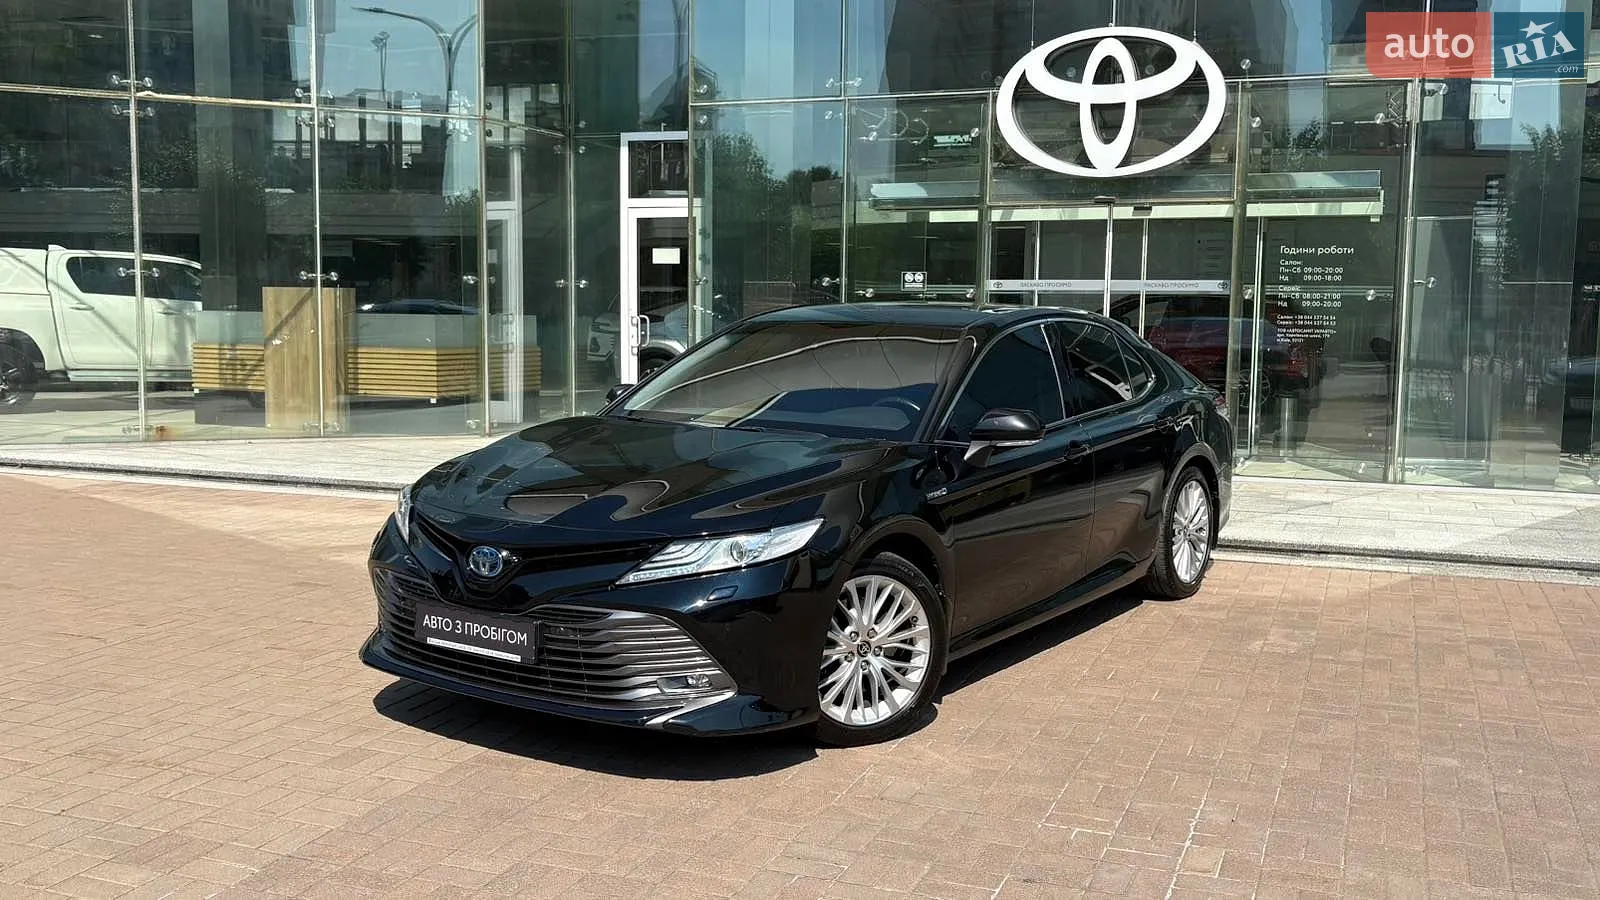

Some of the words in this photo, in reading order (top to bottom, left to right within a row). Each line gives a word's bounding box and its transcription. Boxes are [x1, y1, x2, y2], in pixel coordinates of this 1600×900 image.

[1280, 245, 1315, 255] Години
[1317, 245, 1354, 256] роботи
[1303, 266, 1344, 274] 09:00-20:00
[423, 614, 453, 632] АВТО
[455, 620, 462, 634] З
[464, 621, 528, 647] ПРОБІГОМ
